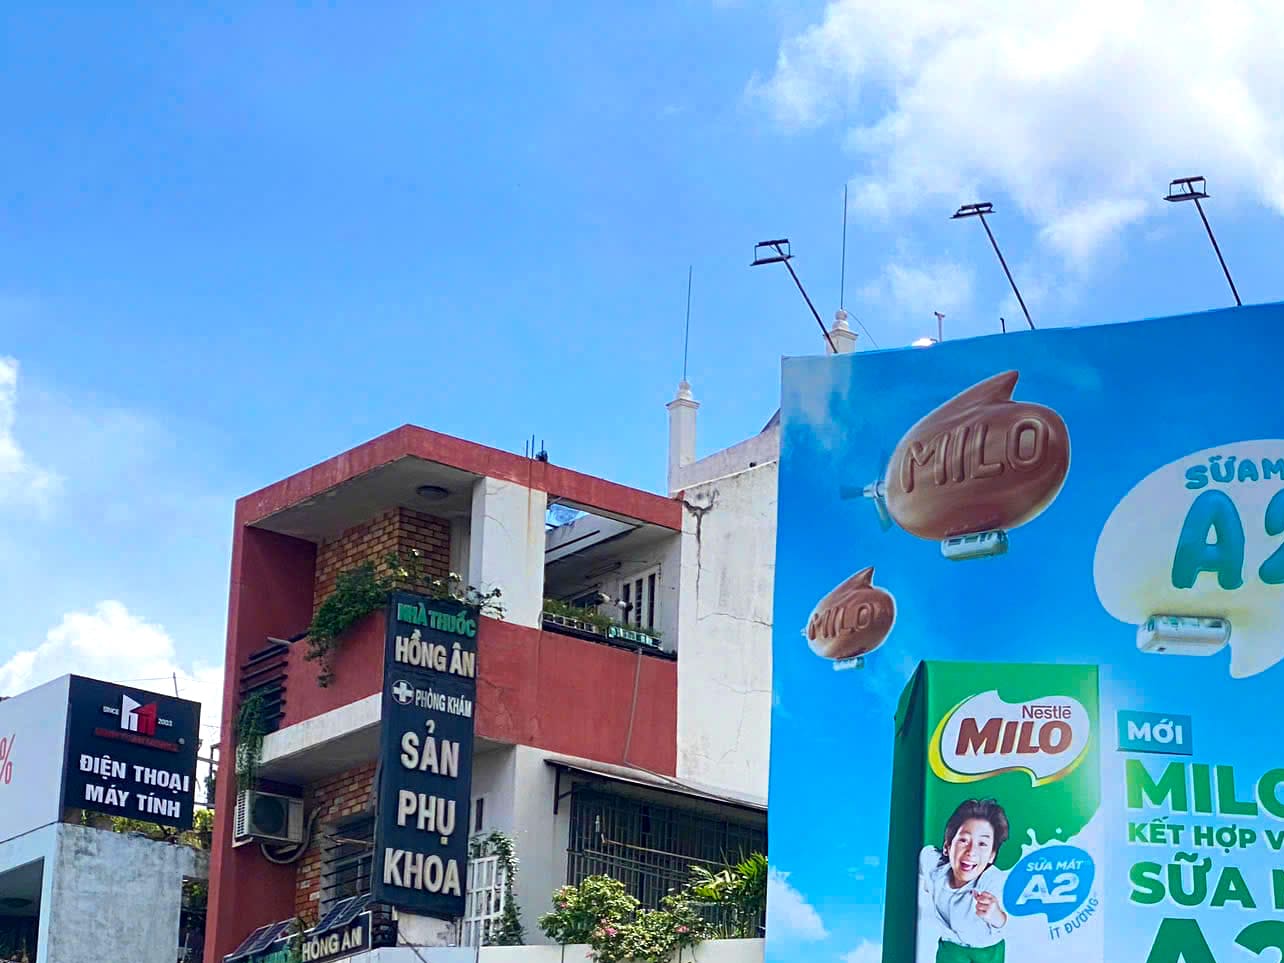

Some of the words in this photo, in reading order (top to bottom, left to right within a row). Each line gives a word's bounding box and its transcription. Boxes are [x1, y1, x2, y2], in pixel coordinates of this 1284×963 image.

[901, 417, 1050, 494] MILO
[1185, 455, 1259, 490] SỮA
[397, 602, 428, 626] NHÀ
[428, 610, 477, 638] THUỐC
[808, 602, 876, 641] MILO
[395, 628, 447, 672] HỒNG
[449, 641, 475, 678] ÂN
[415, 688, 446, 712] PHÒNG
[447, 695, 472, 718] KHÁM
[400, 720, 460, 778] SẢN
[955, 718, 1072, 756] MILO
[1126, 718, 1183, 745] MỚI
[79, 754, 126, 780] ĐIỆN
[133, 765, 190, 794] THOẠI
[85, 784, 129, 808] MÁY
[136, 792, 181, 818] TÍNH
[397, 789, 456, 846] PHỤ
[1128, 816, 1184, 844] KẾT
[1194, 823, 1257, 853] HỢP
[383, 847, 462, 897] KHOA
[1056, 858, 1083, 870] MÁT
[1129, 851, 1257, 907] SỮA
[1016, 872, 1079, 905] A2
[1064, 895, 1099, 934] ĐƯỜNG
